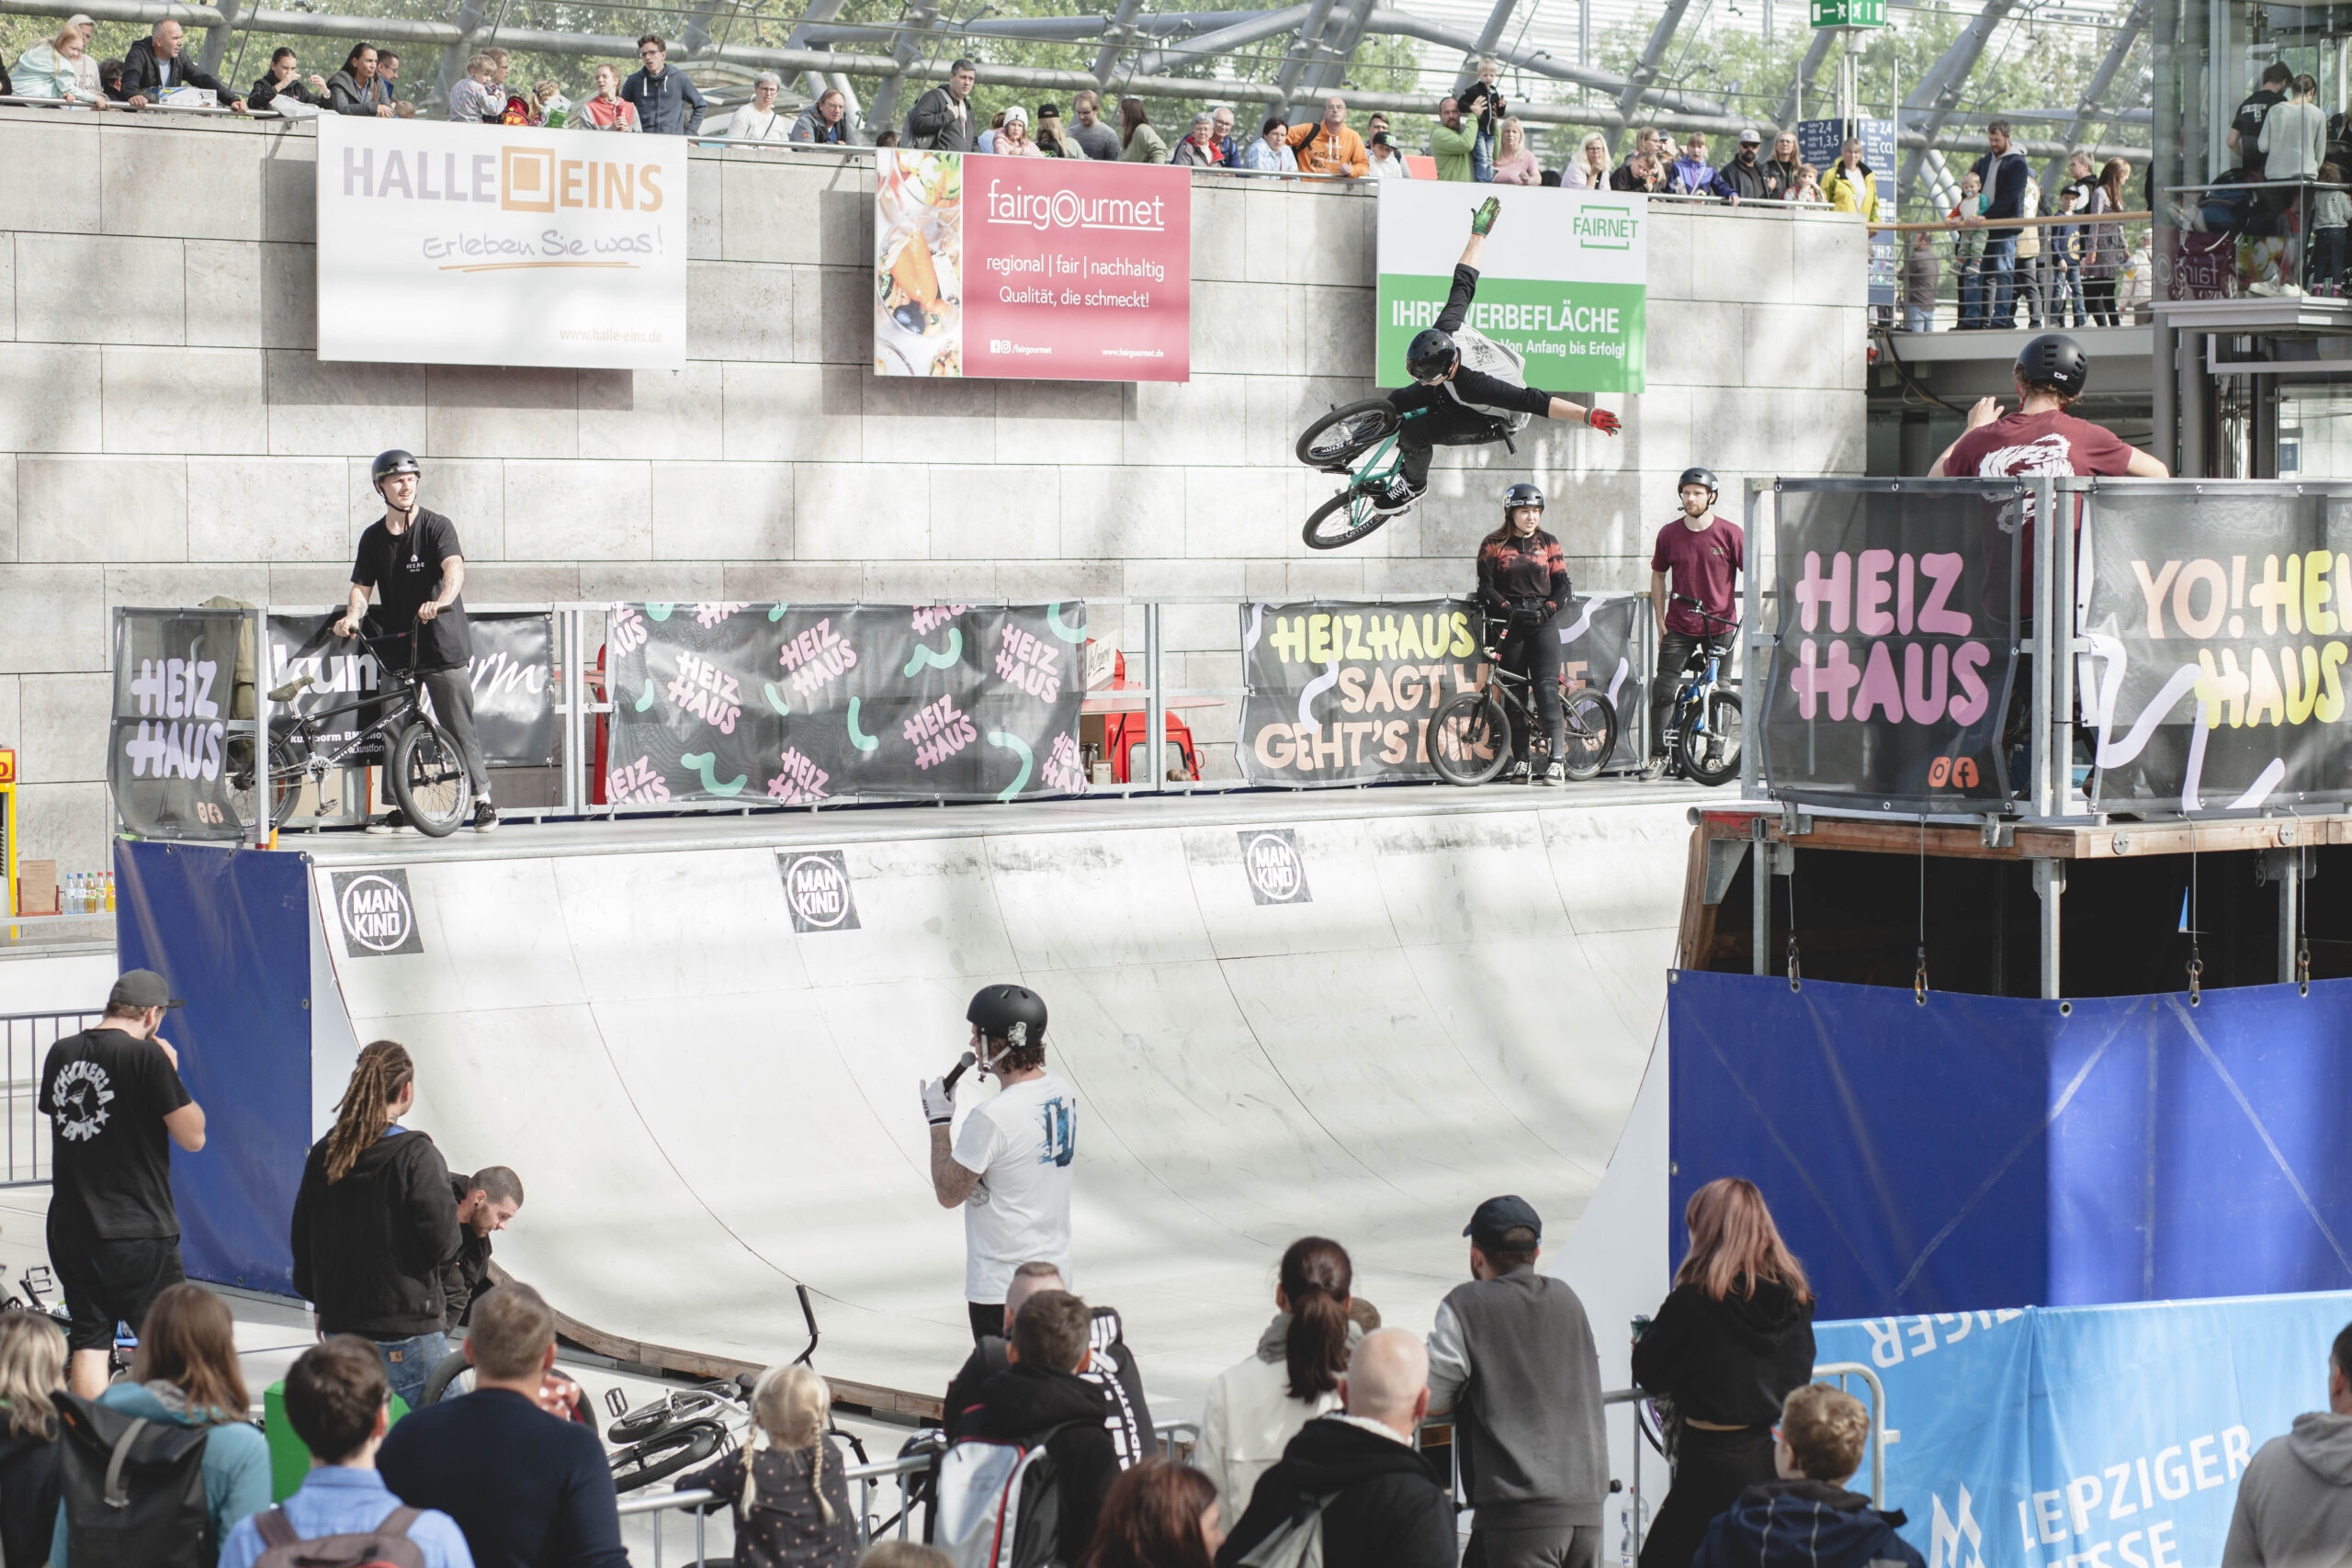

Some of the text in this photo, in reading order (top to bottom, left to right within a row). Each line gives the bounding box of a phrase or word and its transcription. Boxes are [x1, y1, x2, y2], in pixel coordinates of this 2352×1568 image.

[343, 146, 664, 212] HALLE EINS
[422, 224, 664, 260] Erleben Sie was!
[1573, 216, 1639, 239] FAIRNET
[987, 254, 1165, 283] regional fair nachhaltig
[999, 286, 1149, 309] Qualität, die schmeckt!
[1392, 299, 1445, 328] IHRE
[559, 328, 663, 344] www.halle-eins.de
[1102, 348, 1165, 359] www.fairgourmet.de
[1526, 339, 1566, 357] Anfang
[1569, 341, 1587, 355] bis
[1589, 341, 1626, 359] Erfolg!
[1794, 548, 1973, 637] HEIZ
[2131, 555, 2248, 639] YO!
[779, 618, 841, 672] HEIZ
[1001, 623, 1059, 676] HEIZ
[1270, 611, 1476, 664] HEIZHAUS
[131, 658, 219, 719] HEIZ
[675, 650, 741, 705] HEIZ
[791, 638, 857, 697] HAUS
[995, 649, 1061, 704] HAUS
[1338, 664, 1449, 714] SAGT
[1791, 638, 1992, 727] HAUS
[2194, 640, 2349, 729] HAUS
[667, 675, 741, 735] HAUS
[903, 693, 962, 746] HEIZ
[125, 720, 224, 782] HAUS
[915, 714, 978, 771] HAUS
[1254, 718, 1415, 771] GEHT'S
[781, 746, 831, 797] HEIZ
[796, 866, 839, 892] MAN
[1254, 844, 1292, 869] MAN
[1257, 865, 1294, 888] KIND
[353, 885, 399, 914] MAN
[797, 889, 840, 917] KIND
[355, 912, 401, 942] KIND
